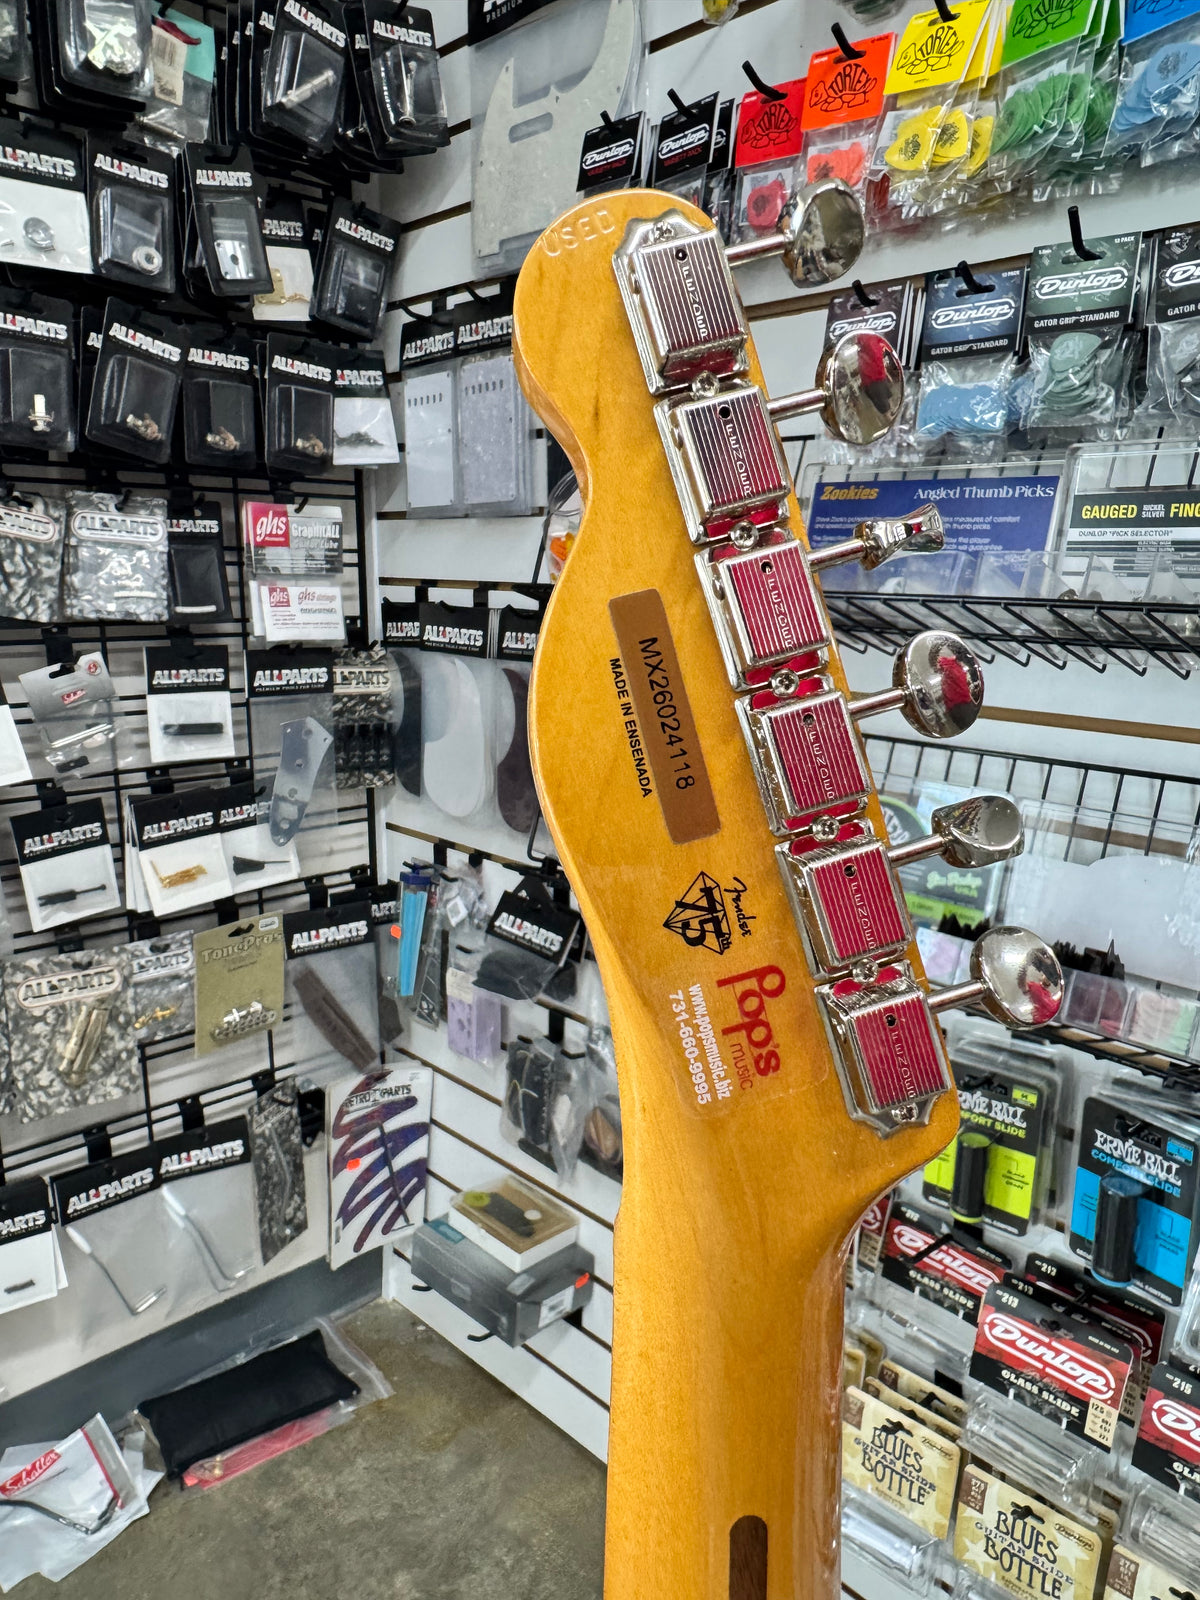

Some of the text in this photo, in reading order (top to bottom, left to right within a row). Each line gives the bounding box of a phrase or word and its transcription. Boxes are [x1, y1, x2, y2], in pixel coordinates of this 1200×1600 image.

[284, 0, 346, 47] ALLPARTS
[373, 19, 432, 47] ALLPARTS
[585, 142, 630, 166] Dunlop
[661, 128, 707, 154] Dunlop
[94, 153, 169, 188] ALLPARTS
[196, 169, 252, 187] ALLPARTS
[335, 217, 394, 252] ALLPARTS
[540, 210, 616, 257] USED
[1040, 272, 1124, 294] Dunlop
[936, 303, 1011, 325] Dunlop
[1034, 318, 1058, 329] GATOR
[1080, 310, 1120, 324] STANDARD
[1167, 305, 1196, 316] GATOR
[835, 316, 893, 336] Dunlop
[109, 322, 181, 362] ALLPARTS
[403, 331, 454, 360] ALLPARTS
[187, 348, 250, 371] ALLPARTS
[272, 355, 331, 382] ALLPARTS
[820, 485, 879, 501] Zookies
[913, 485, 1055, 501] Angled Thumb Picks
[256, 510, 286, 542] ghs
[1081, 504, 1138, 519] GAUGED
[1141, 510, 1165, 518] SILVER
[270, 588, 288, 606] ghs
[298, 588, 316, 605] ghs
[423, 624, 484, 647] ALLPARTS
[152, 667, 225, 685] ALLPARTS
[253, 667, 328, 687] ALLPARTS
[638, 636, 695, 790] MX26024118
[609, 658, 653, 798] MADE IN ENSENADA
[23, 822, 103, 854] ALLPARTS
[142, 812, 213, 840] ALLPARTS
[723, 876, 757, 938] Fender
[291, 920, 369, 949] ALLPARTS
[494, 912, 563, 952] ALLPARTS
[716, 964, 787, 1077] Pop's
[669, 989, 712, 1105] 731-660-9995
[688, 983, 733, 1101] www.popsmusic.biz
[730, 1042, 754, 1092] music
[990, 1099, 1027, 1128] BALL
[994, 1120, 1026, 1139] SLIDE
[159, 1139, 244, 1174] ALLPARTS
[1143, 1149, 1182, 1186] BALL
[66, 1167, 154, 1215] ALLPARTS
[1149, 1176, 1181, 1198] SLIDE
[909, 1270, 975, 1309] GLASS SLIDE
[992, 1319, 1108, 1393] Dunlop
[1001, 1369, 1080, 1417] GLASS SLIDE
[871, 1426, 924, 1474] BLUES
[861, 1449, 925, 1506] BOTTLE
[901, 1465, 936, 1492] SLIDE
[994, 1510, 1059, 1565] BLUES
[975, 1522, 1074, 1586] GUITAR SLIDE
[984, 1534, 1063, 1600] BOTTLE
